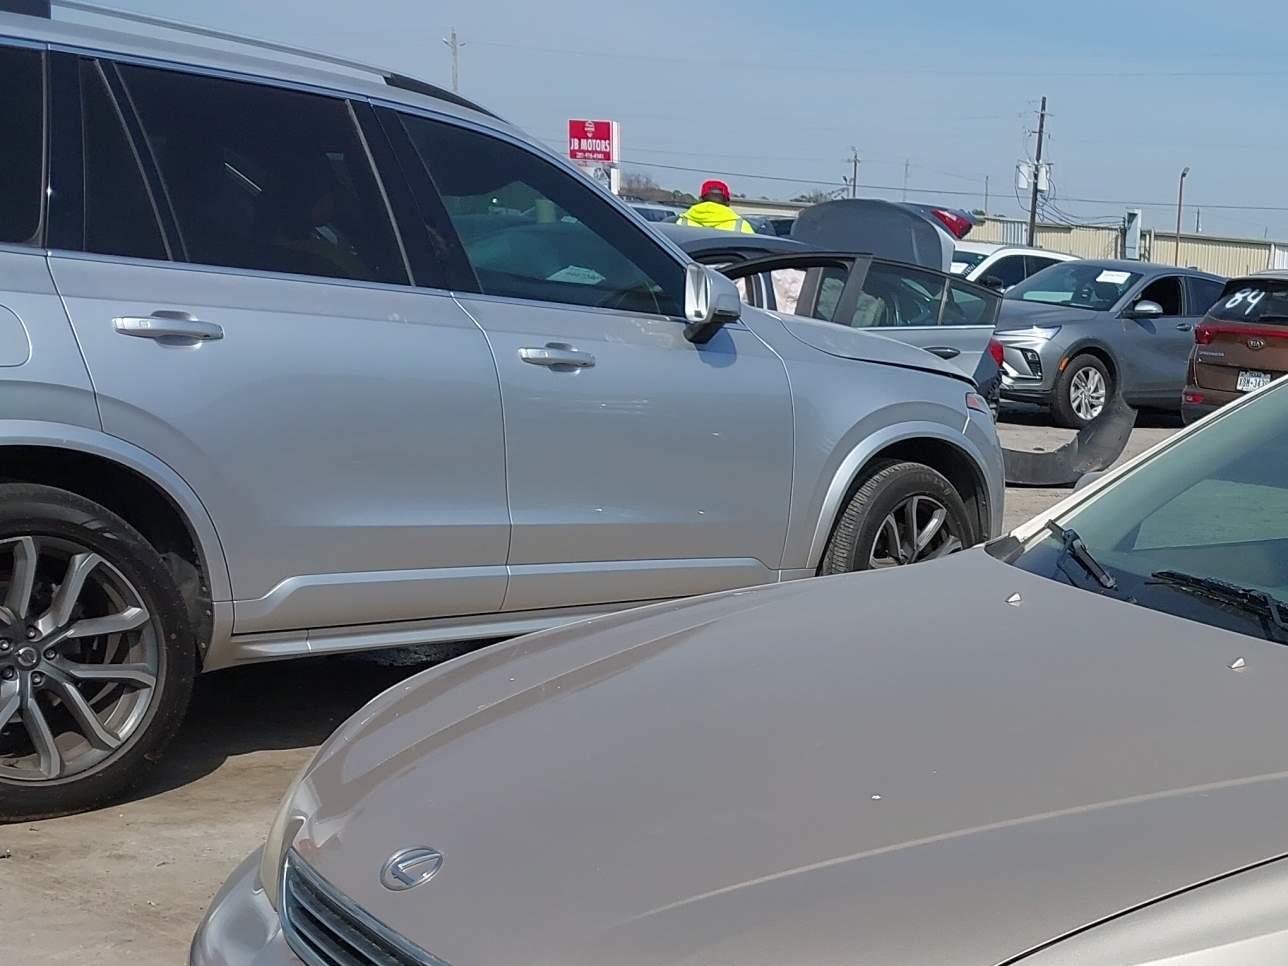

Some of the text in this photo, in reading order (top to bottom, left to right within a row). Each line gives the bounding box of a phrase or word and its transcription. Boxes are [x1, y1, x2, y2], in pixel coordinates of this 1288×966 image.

[570, 138, 610, 152] JB MOTORS
[1225, 288, 1265, 315] 84
